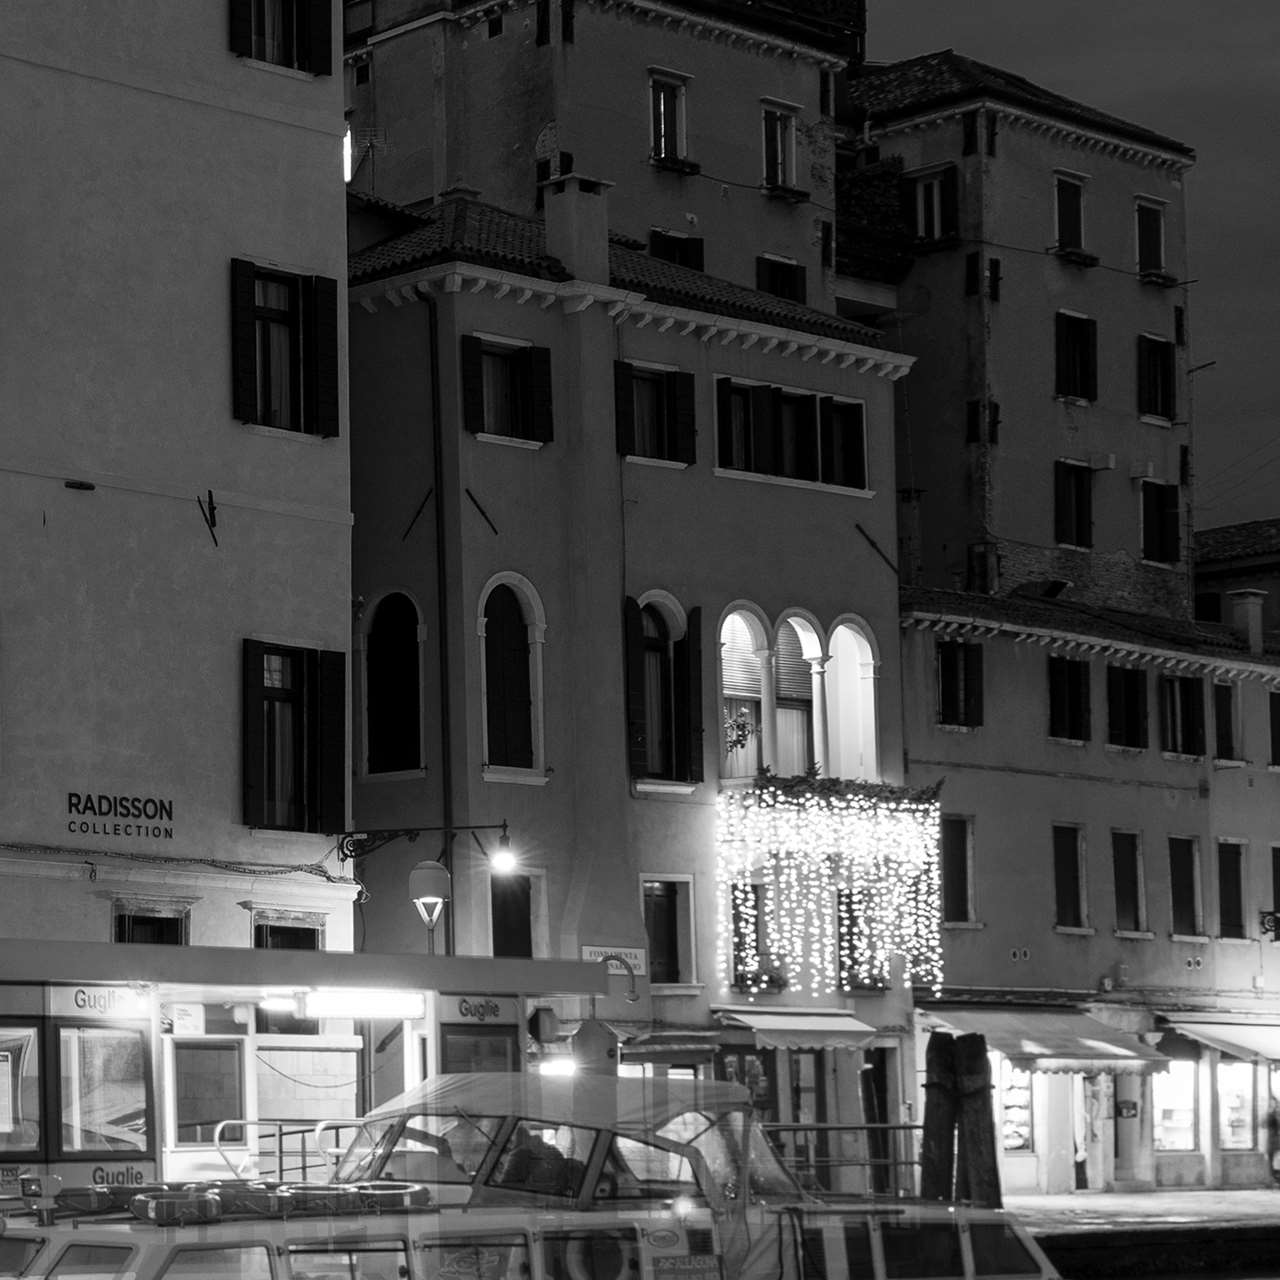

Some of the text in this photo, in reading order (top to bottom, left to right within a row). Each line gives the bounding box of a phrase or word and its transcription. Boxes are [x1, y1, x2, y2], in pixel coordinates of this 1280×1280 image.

[67, 793, 173, 821] RADISSON
[67, 821, 173, 839] COLLECTION
[74, 989, 120, 1014] Gugli
[458, 998, 500, 1022] Guglie
